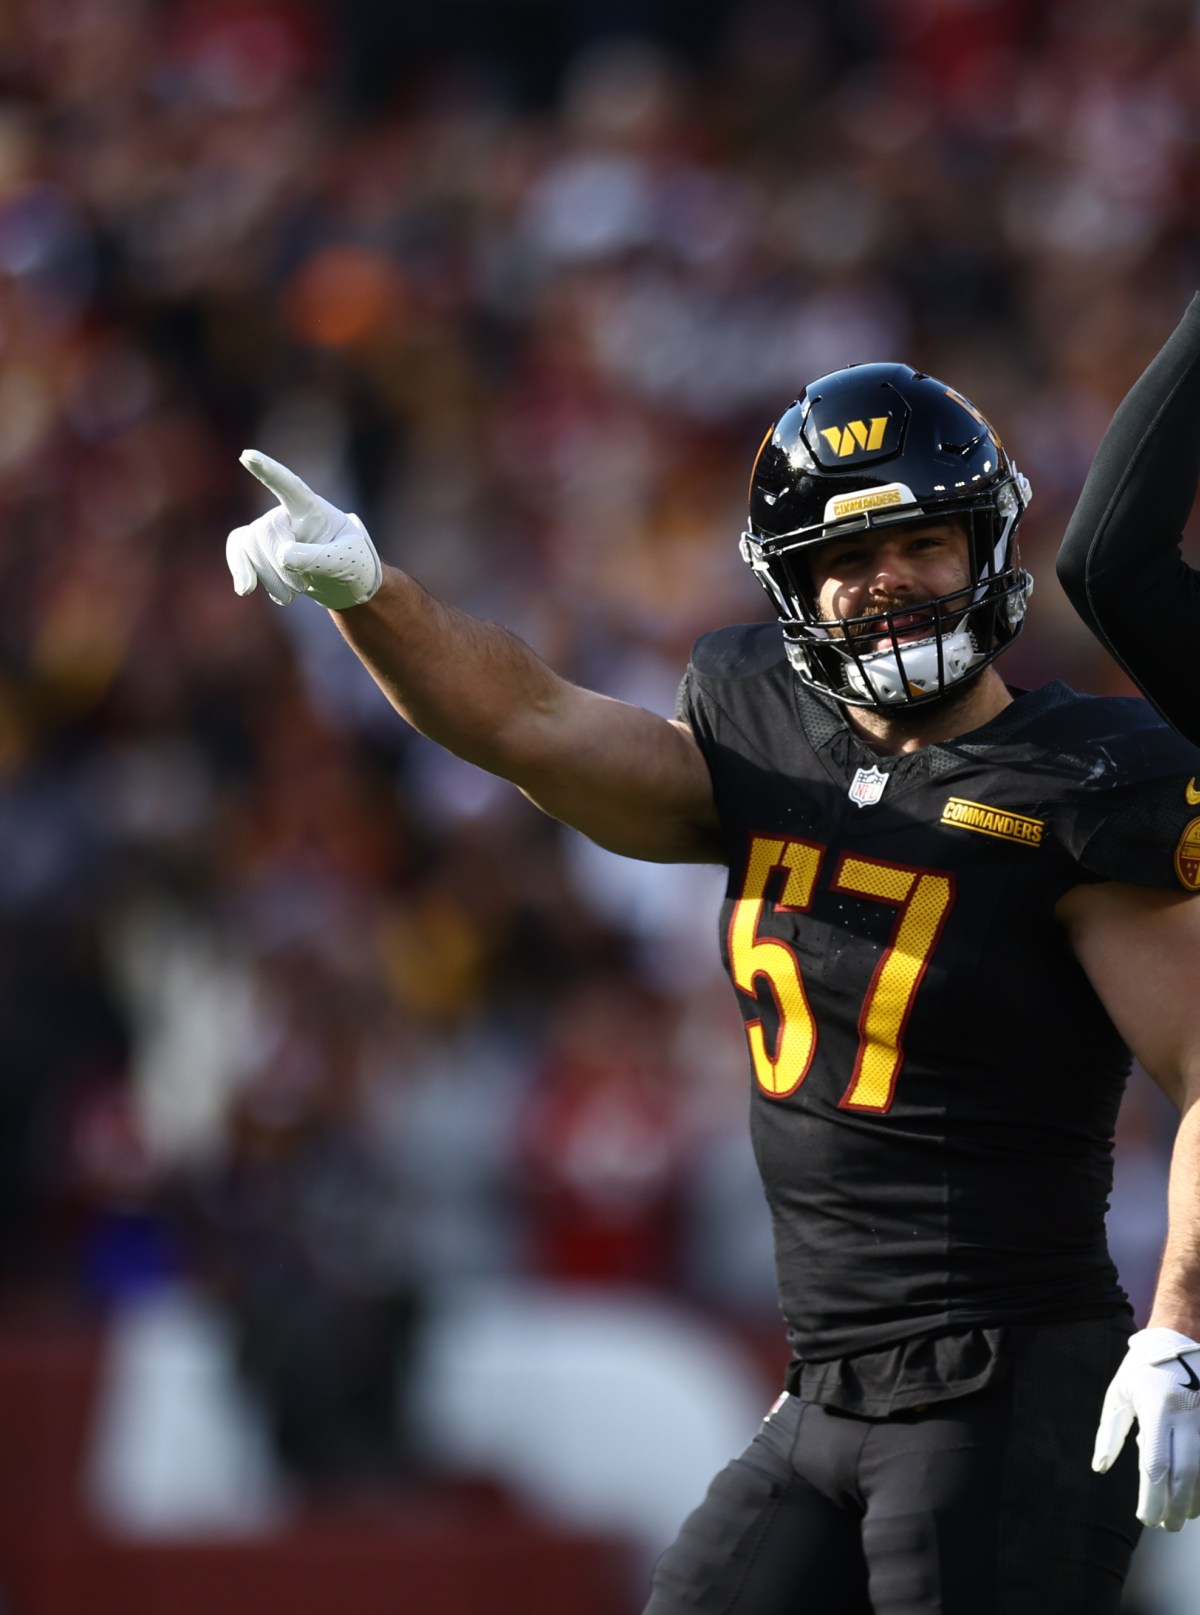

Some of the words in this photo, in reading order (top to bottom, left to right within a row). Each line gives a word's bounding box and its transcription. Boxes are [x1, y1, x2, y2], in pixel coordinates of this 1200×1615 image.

[855, 782, 882, 801] NFL
[942, 801, 1045, 843] COMMANDERS
[727, 830, 957, 1114] 57
